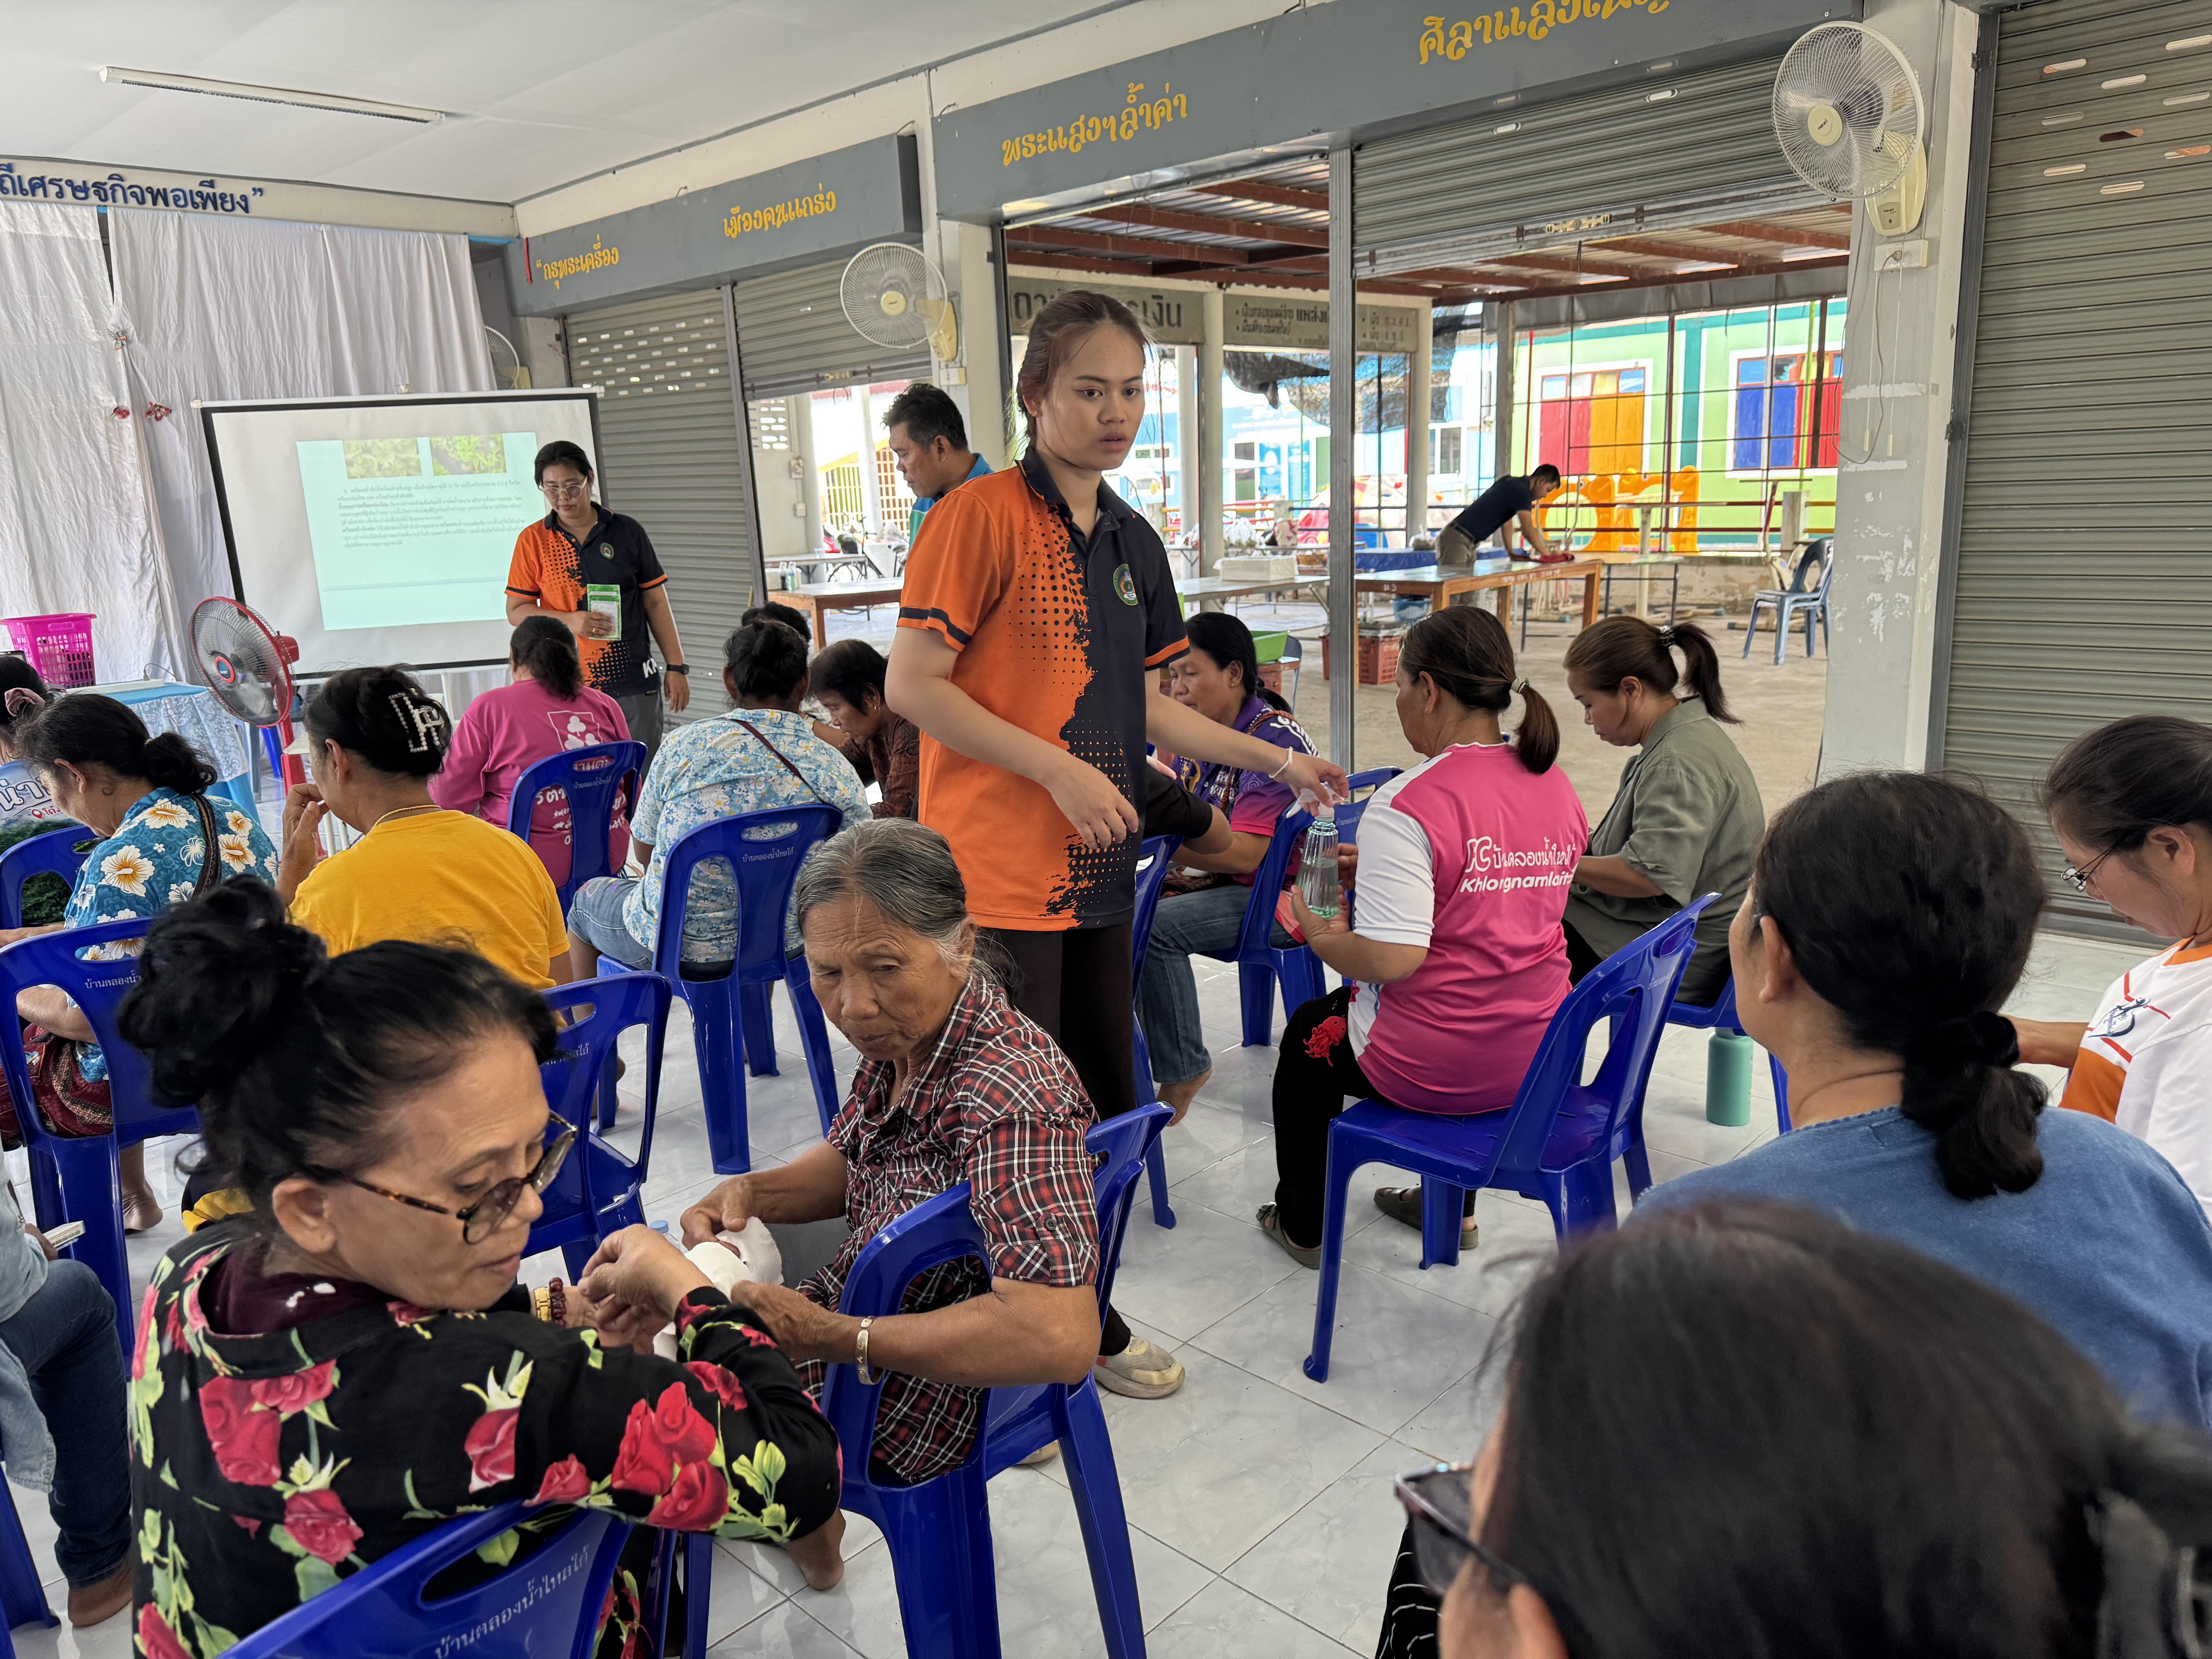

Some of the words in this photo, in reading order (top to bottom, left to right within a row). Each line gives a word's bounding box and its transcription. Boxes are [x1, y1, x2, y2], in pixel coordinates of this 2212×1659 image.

[723, 183, 837, 238] เมืองคนแกร่ง
